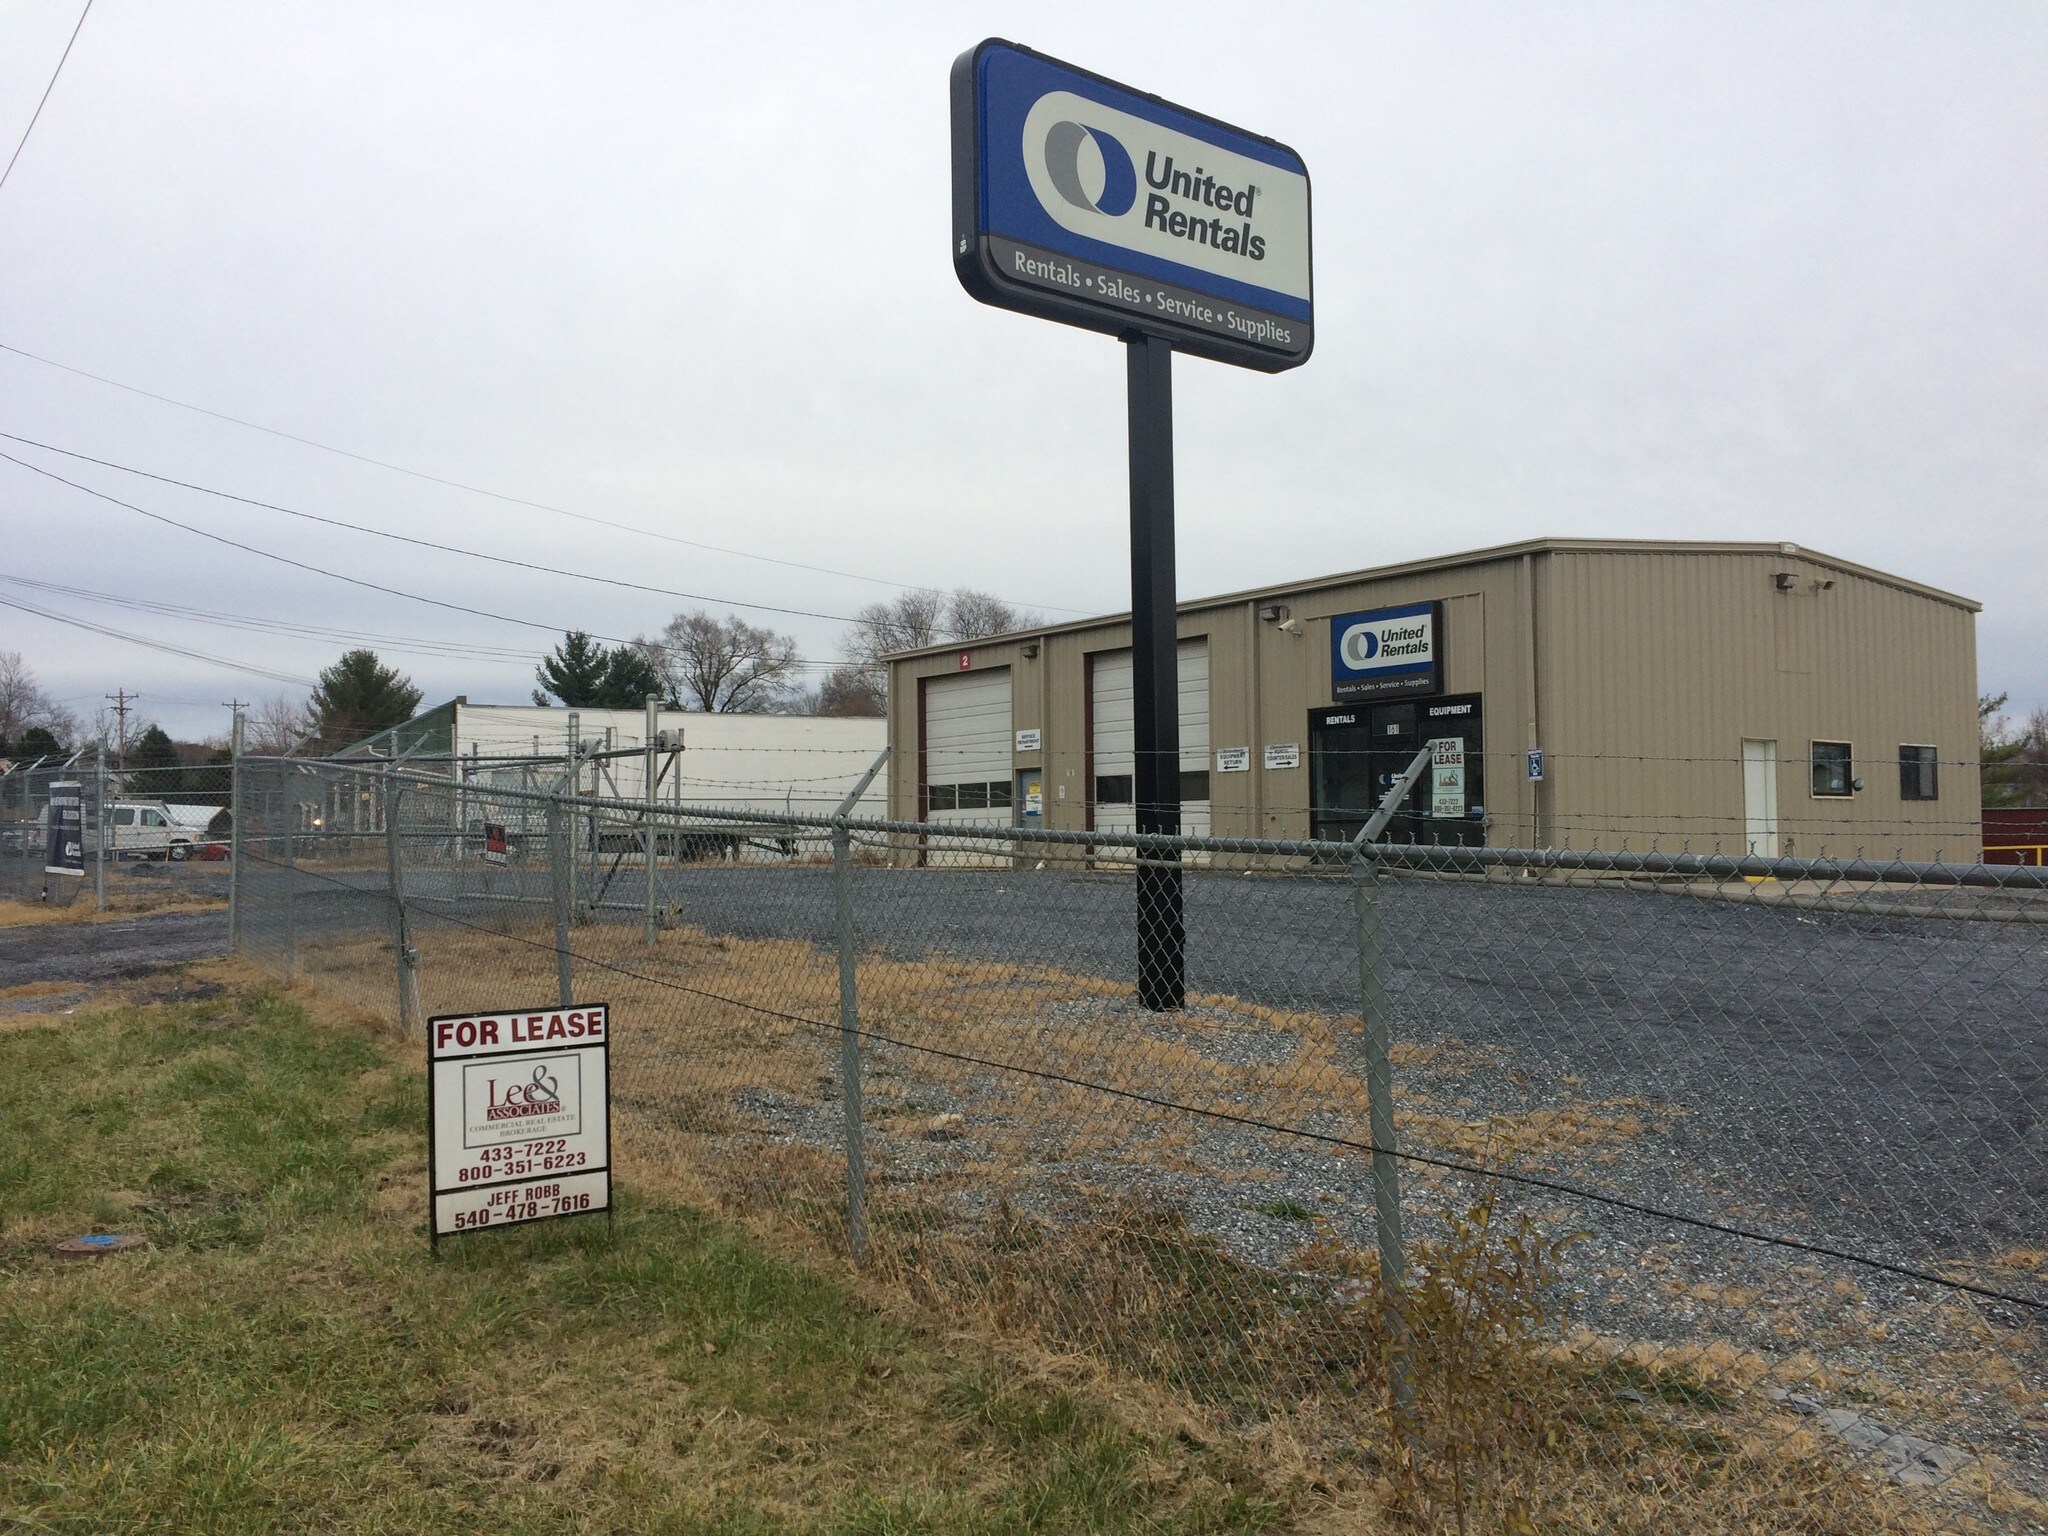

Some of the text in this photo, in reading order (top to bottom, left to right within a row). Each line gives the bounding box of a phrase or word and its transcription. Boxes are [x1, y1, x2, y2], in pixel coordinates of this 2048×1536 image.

[1145, 150, 1256, 219] United
[1144, 193, 1266, 261] Rentals
[1014, 250, 1291, 345] Rentals Sales Service Supplies
[1380, 624, 1425, 643] United
[1380, 640, 1429, 658] Rentals
[962, 655, 969, 668] 2
[1336, 677, 1430, 694] Rentals Sales Service Supplies
[1326, 714, 1355, 725] RENTALS
[1429, 704, 1472, 717] EQUIPMENT
[1438, 741, 1457, 752] FOR
[1434, 754, 1462, 765] LEASE
[437, 1011, 603, 1049] FOR LEASE
[487, 1101, 561, 1121] ASSOCIATES
[469, 1113, 577, 1133] COMMERCIAL REAL ESTATE
[499, 1125, 548, 1138] BROKERAGE
[480, 1139, 567, 1163] 433-7222
[458, 1152, 587, 1183] 800-351-6223
[487, 1183, 561, 1208] JEFF ROBB
